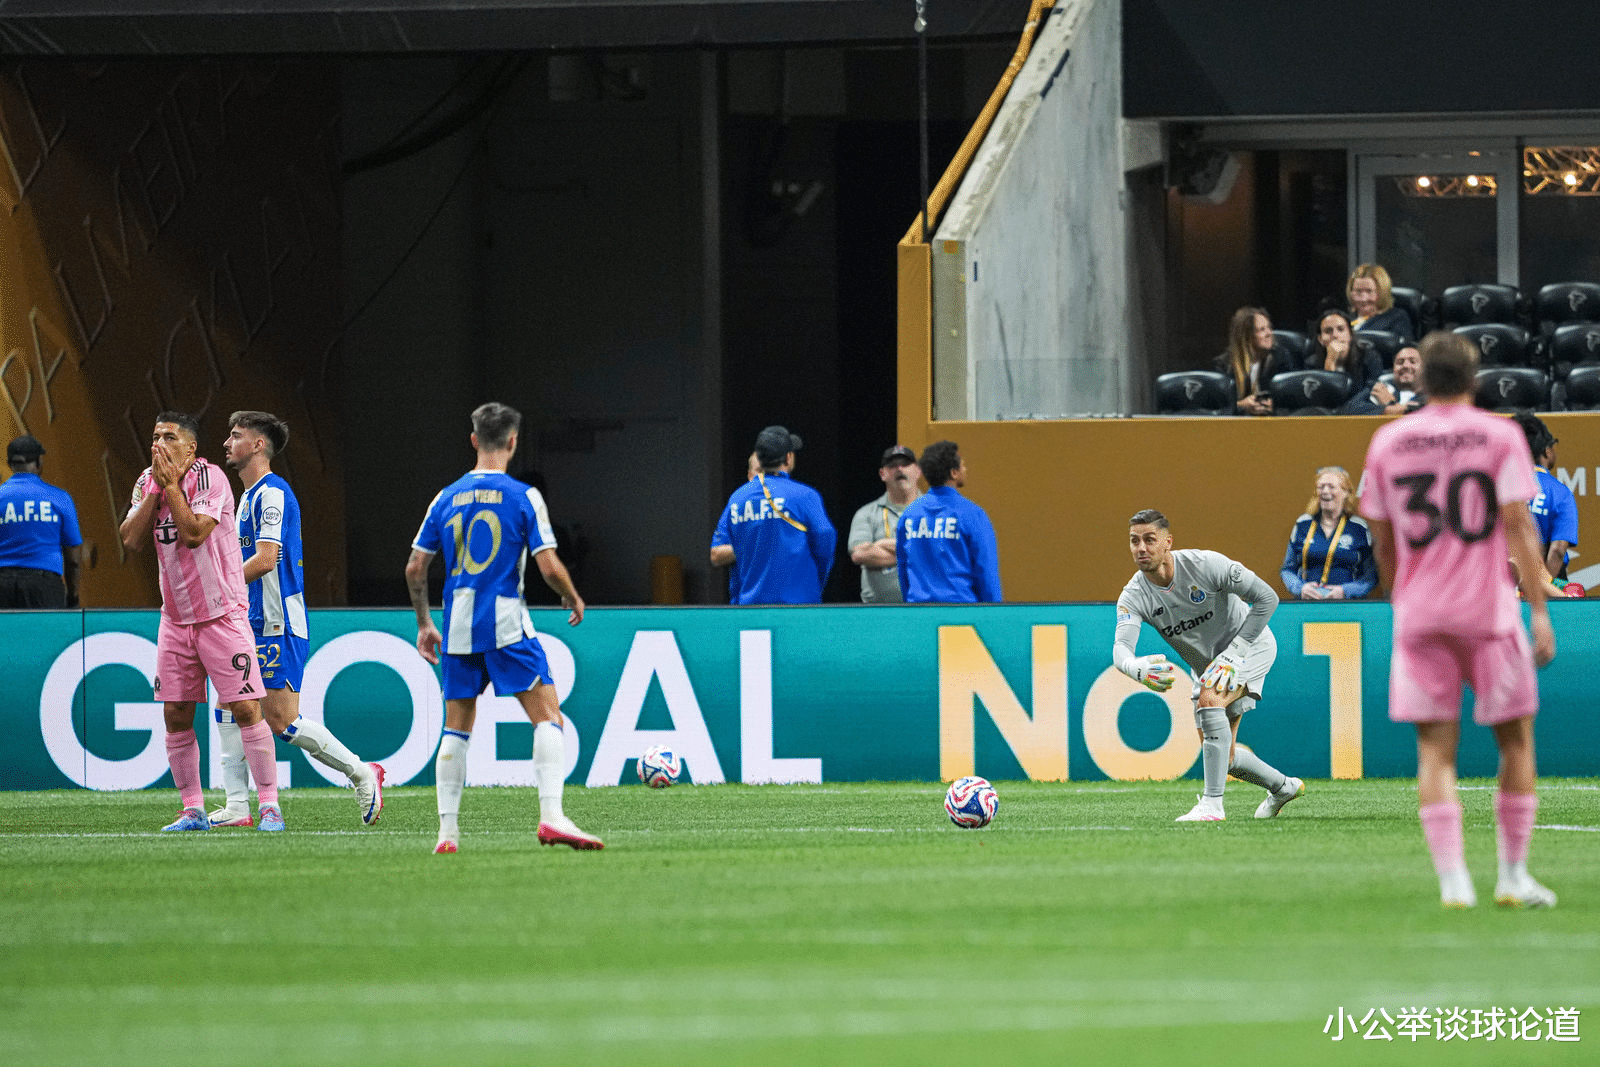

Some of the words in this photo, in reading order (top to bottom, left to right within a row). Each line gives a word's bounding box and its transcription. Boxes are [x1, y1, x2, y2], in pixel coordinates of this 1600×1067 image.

[0, 500, 59, 524] .A.F.E.
[1392, 470, 1497, 549] 30
[904, 516, 960, 540] S.A.F.E.
[444, 509, 502, 577] 10
[1161, 610, 1214, 638] Betano
[231, 652, 252, 681] 9
[255, 643, 281, 668] 52
[1302, 621, 1363, 780] 1
